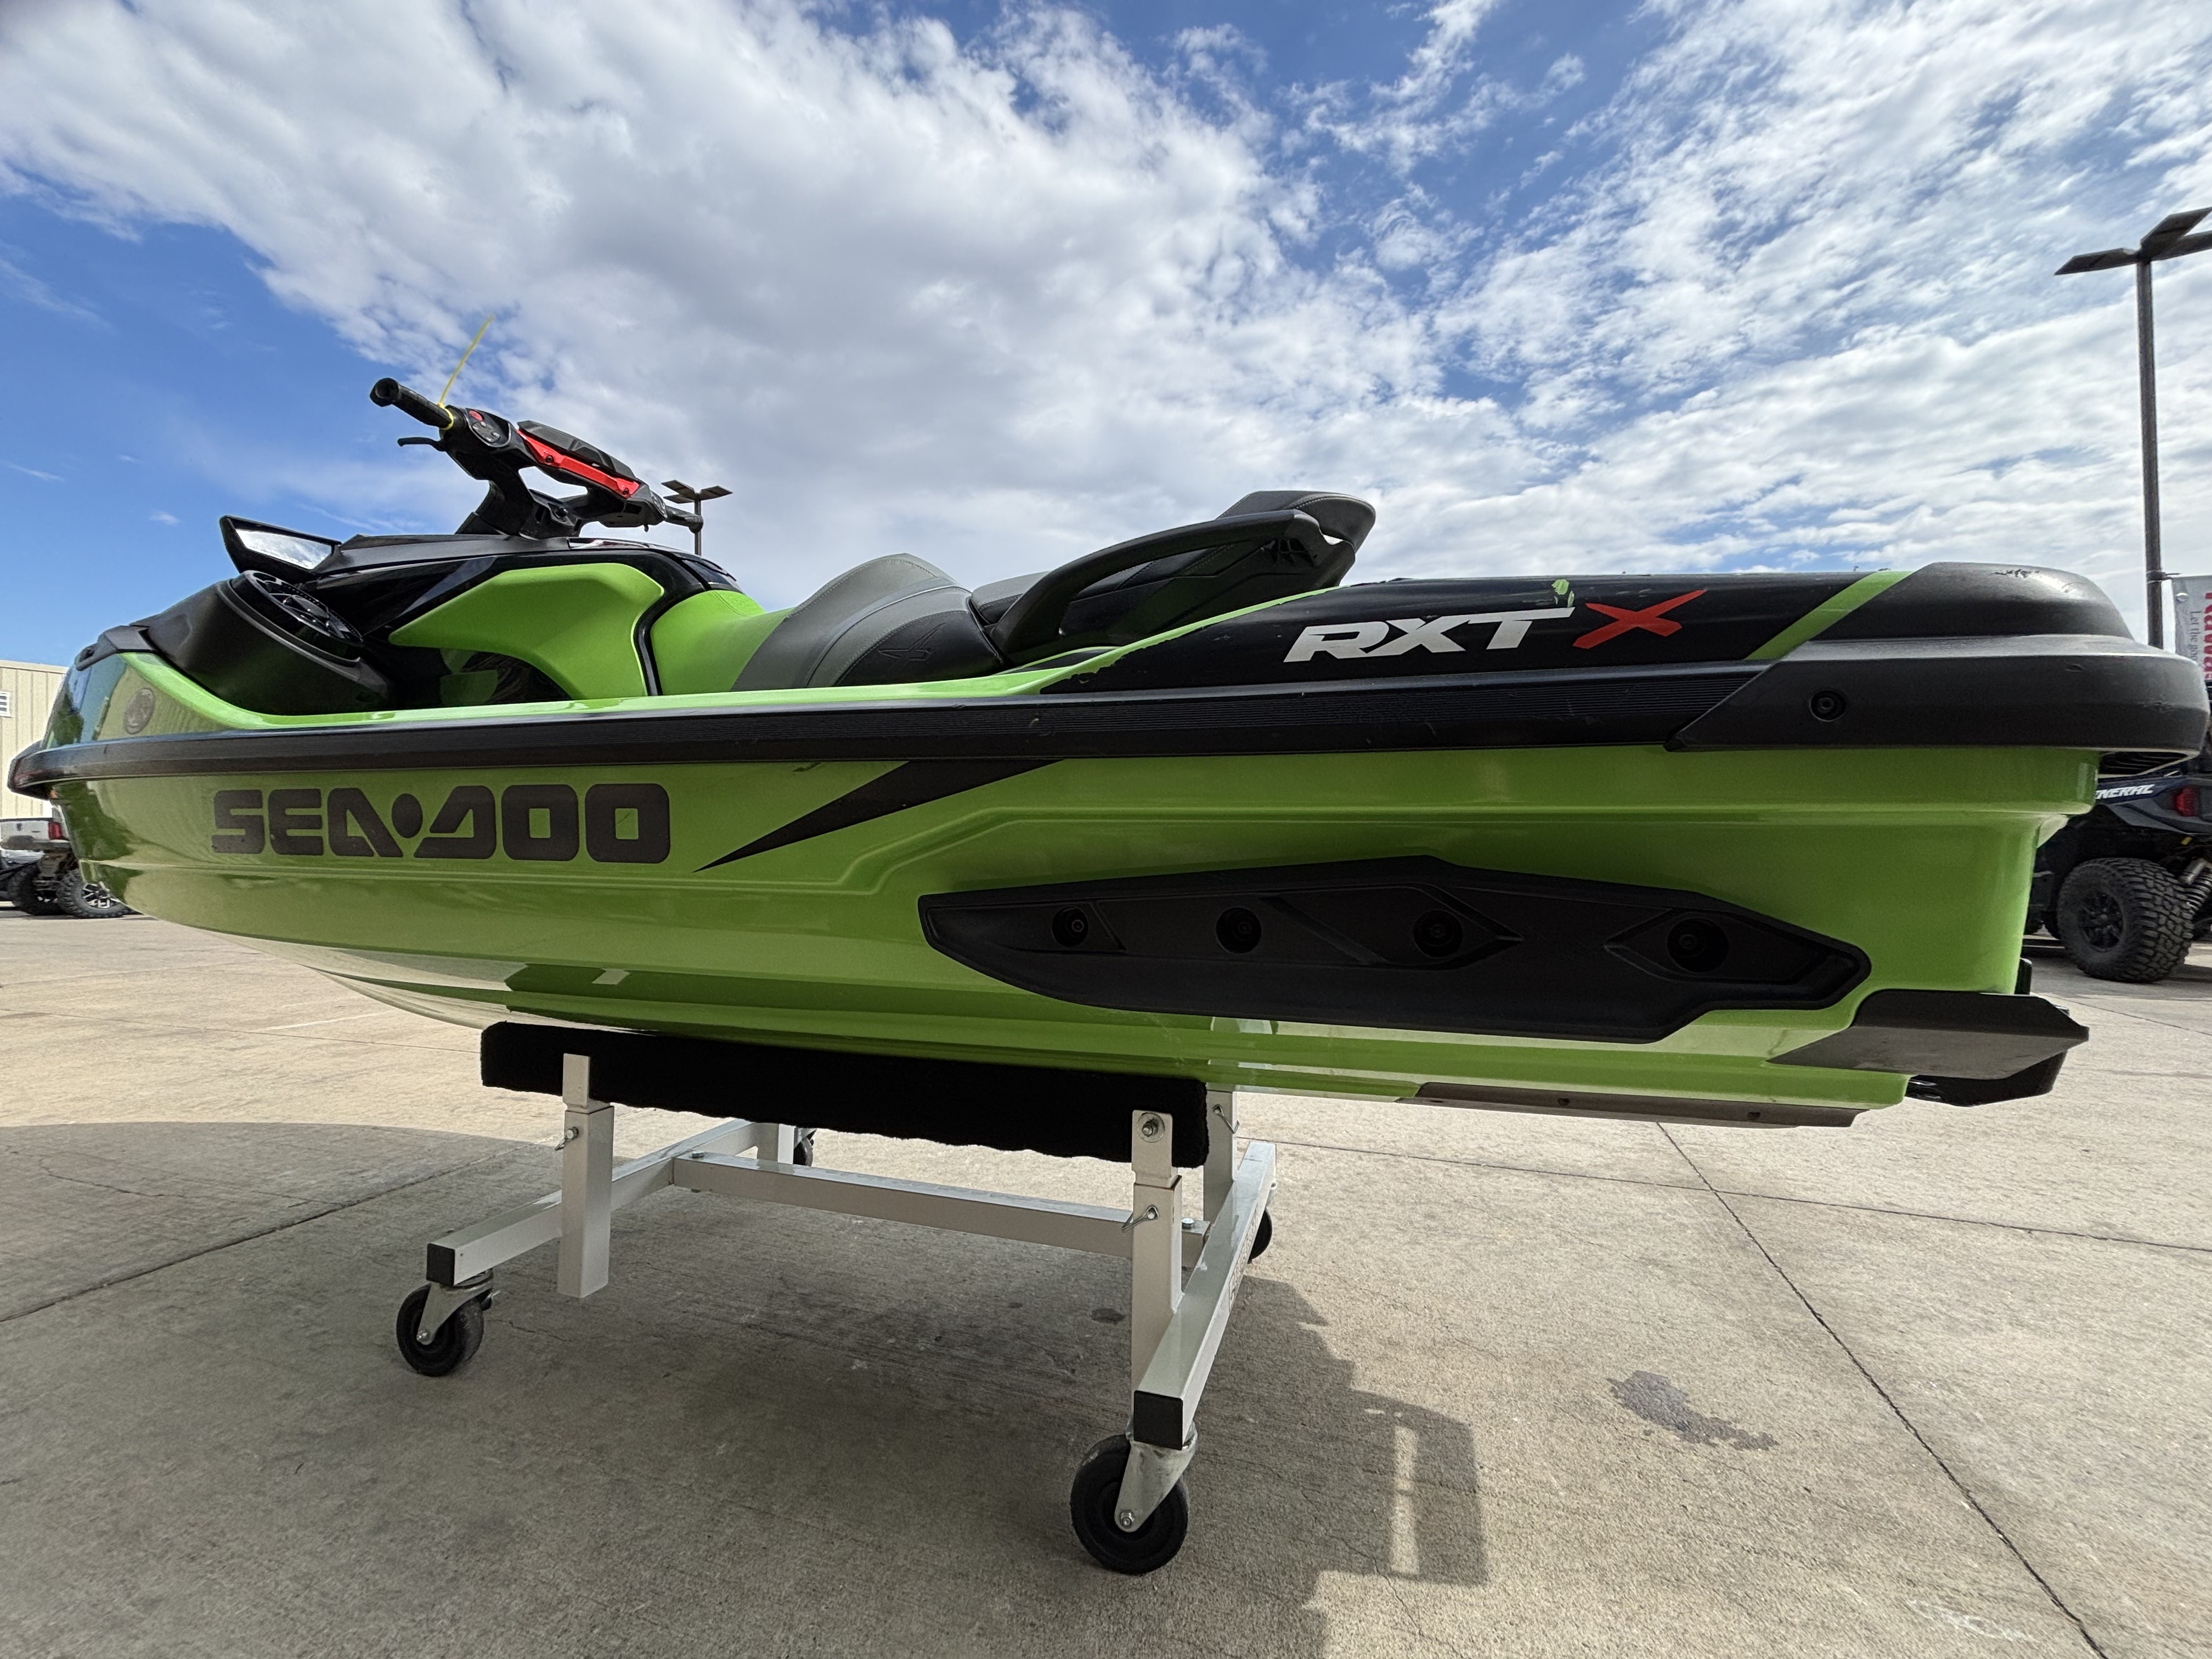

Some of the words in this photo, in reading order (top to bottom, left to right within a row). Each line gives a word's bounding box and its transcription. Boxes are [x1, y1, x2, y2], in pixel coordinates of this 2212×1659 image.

[2190, 611, 2202, 625] Let
[1283, 607, 1576, 663] RXT
[1572, 589, 1707, 650] X
[2190, 628, 2201, 642] the
[2094, 784, 2155, 799] NERAL
